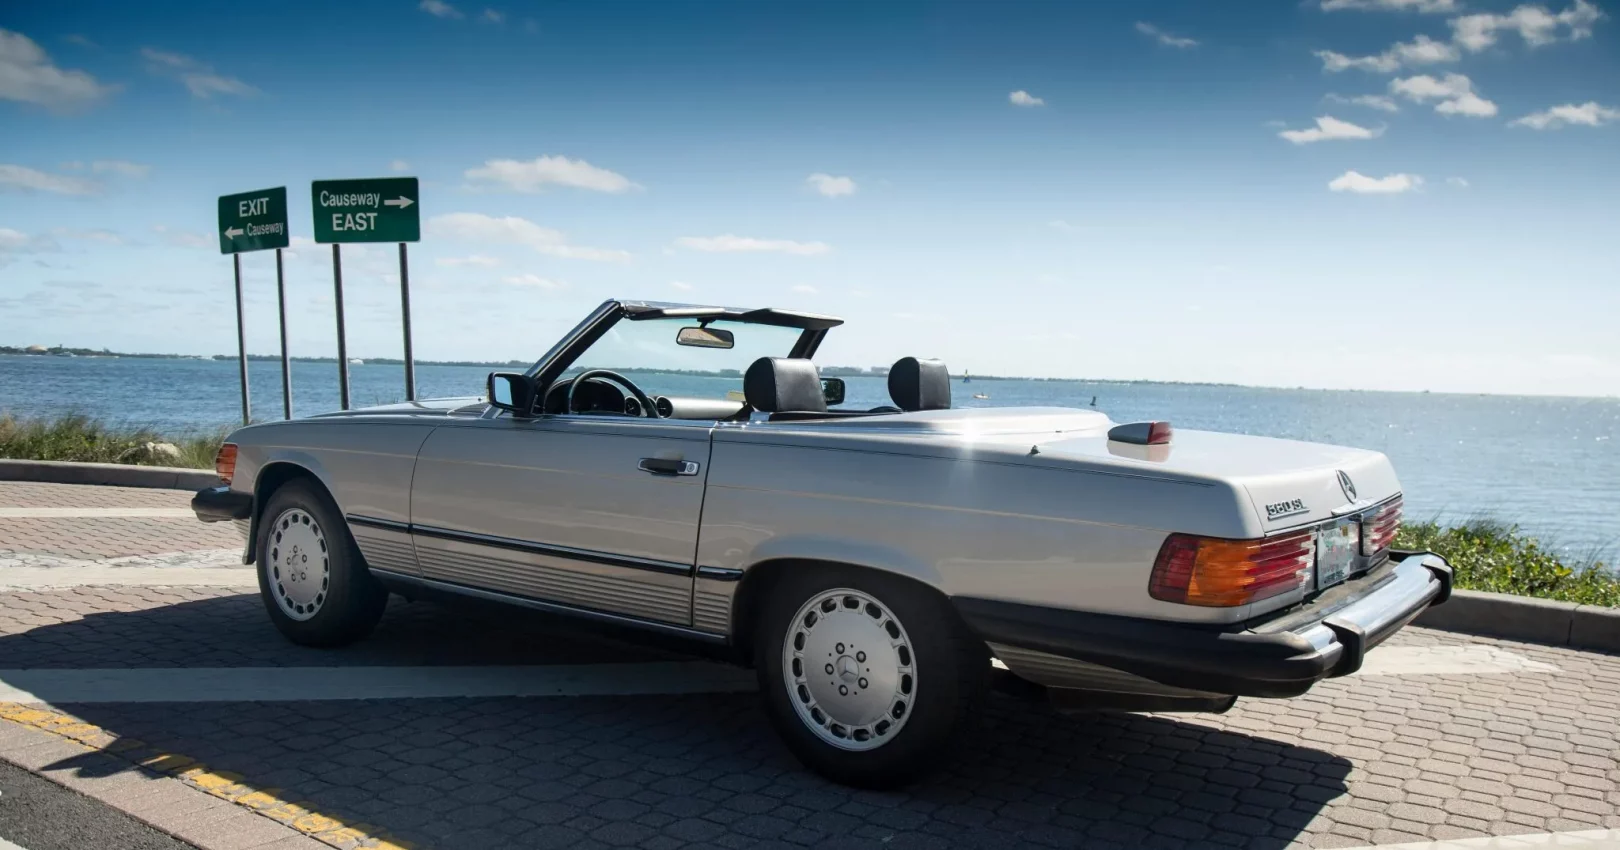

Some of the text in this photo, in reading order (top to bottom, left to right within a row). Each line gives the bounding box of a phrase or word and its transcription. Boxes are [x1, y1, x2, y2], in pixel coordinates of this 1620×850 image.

[239, 197, 270, 218] EXIT
[320, 190, 381, 209] Causeway
[246, 222, 284, 237] Causeway
[332, 212, 378, 231] EAST
